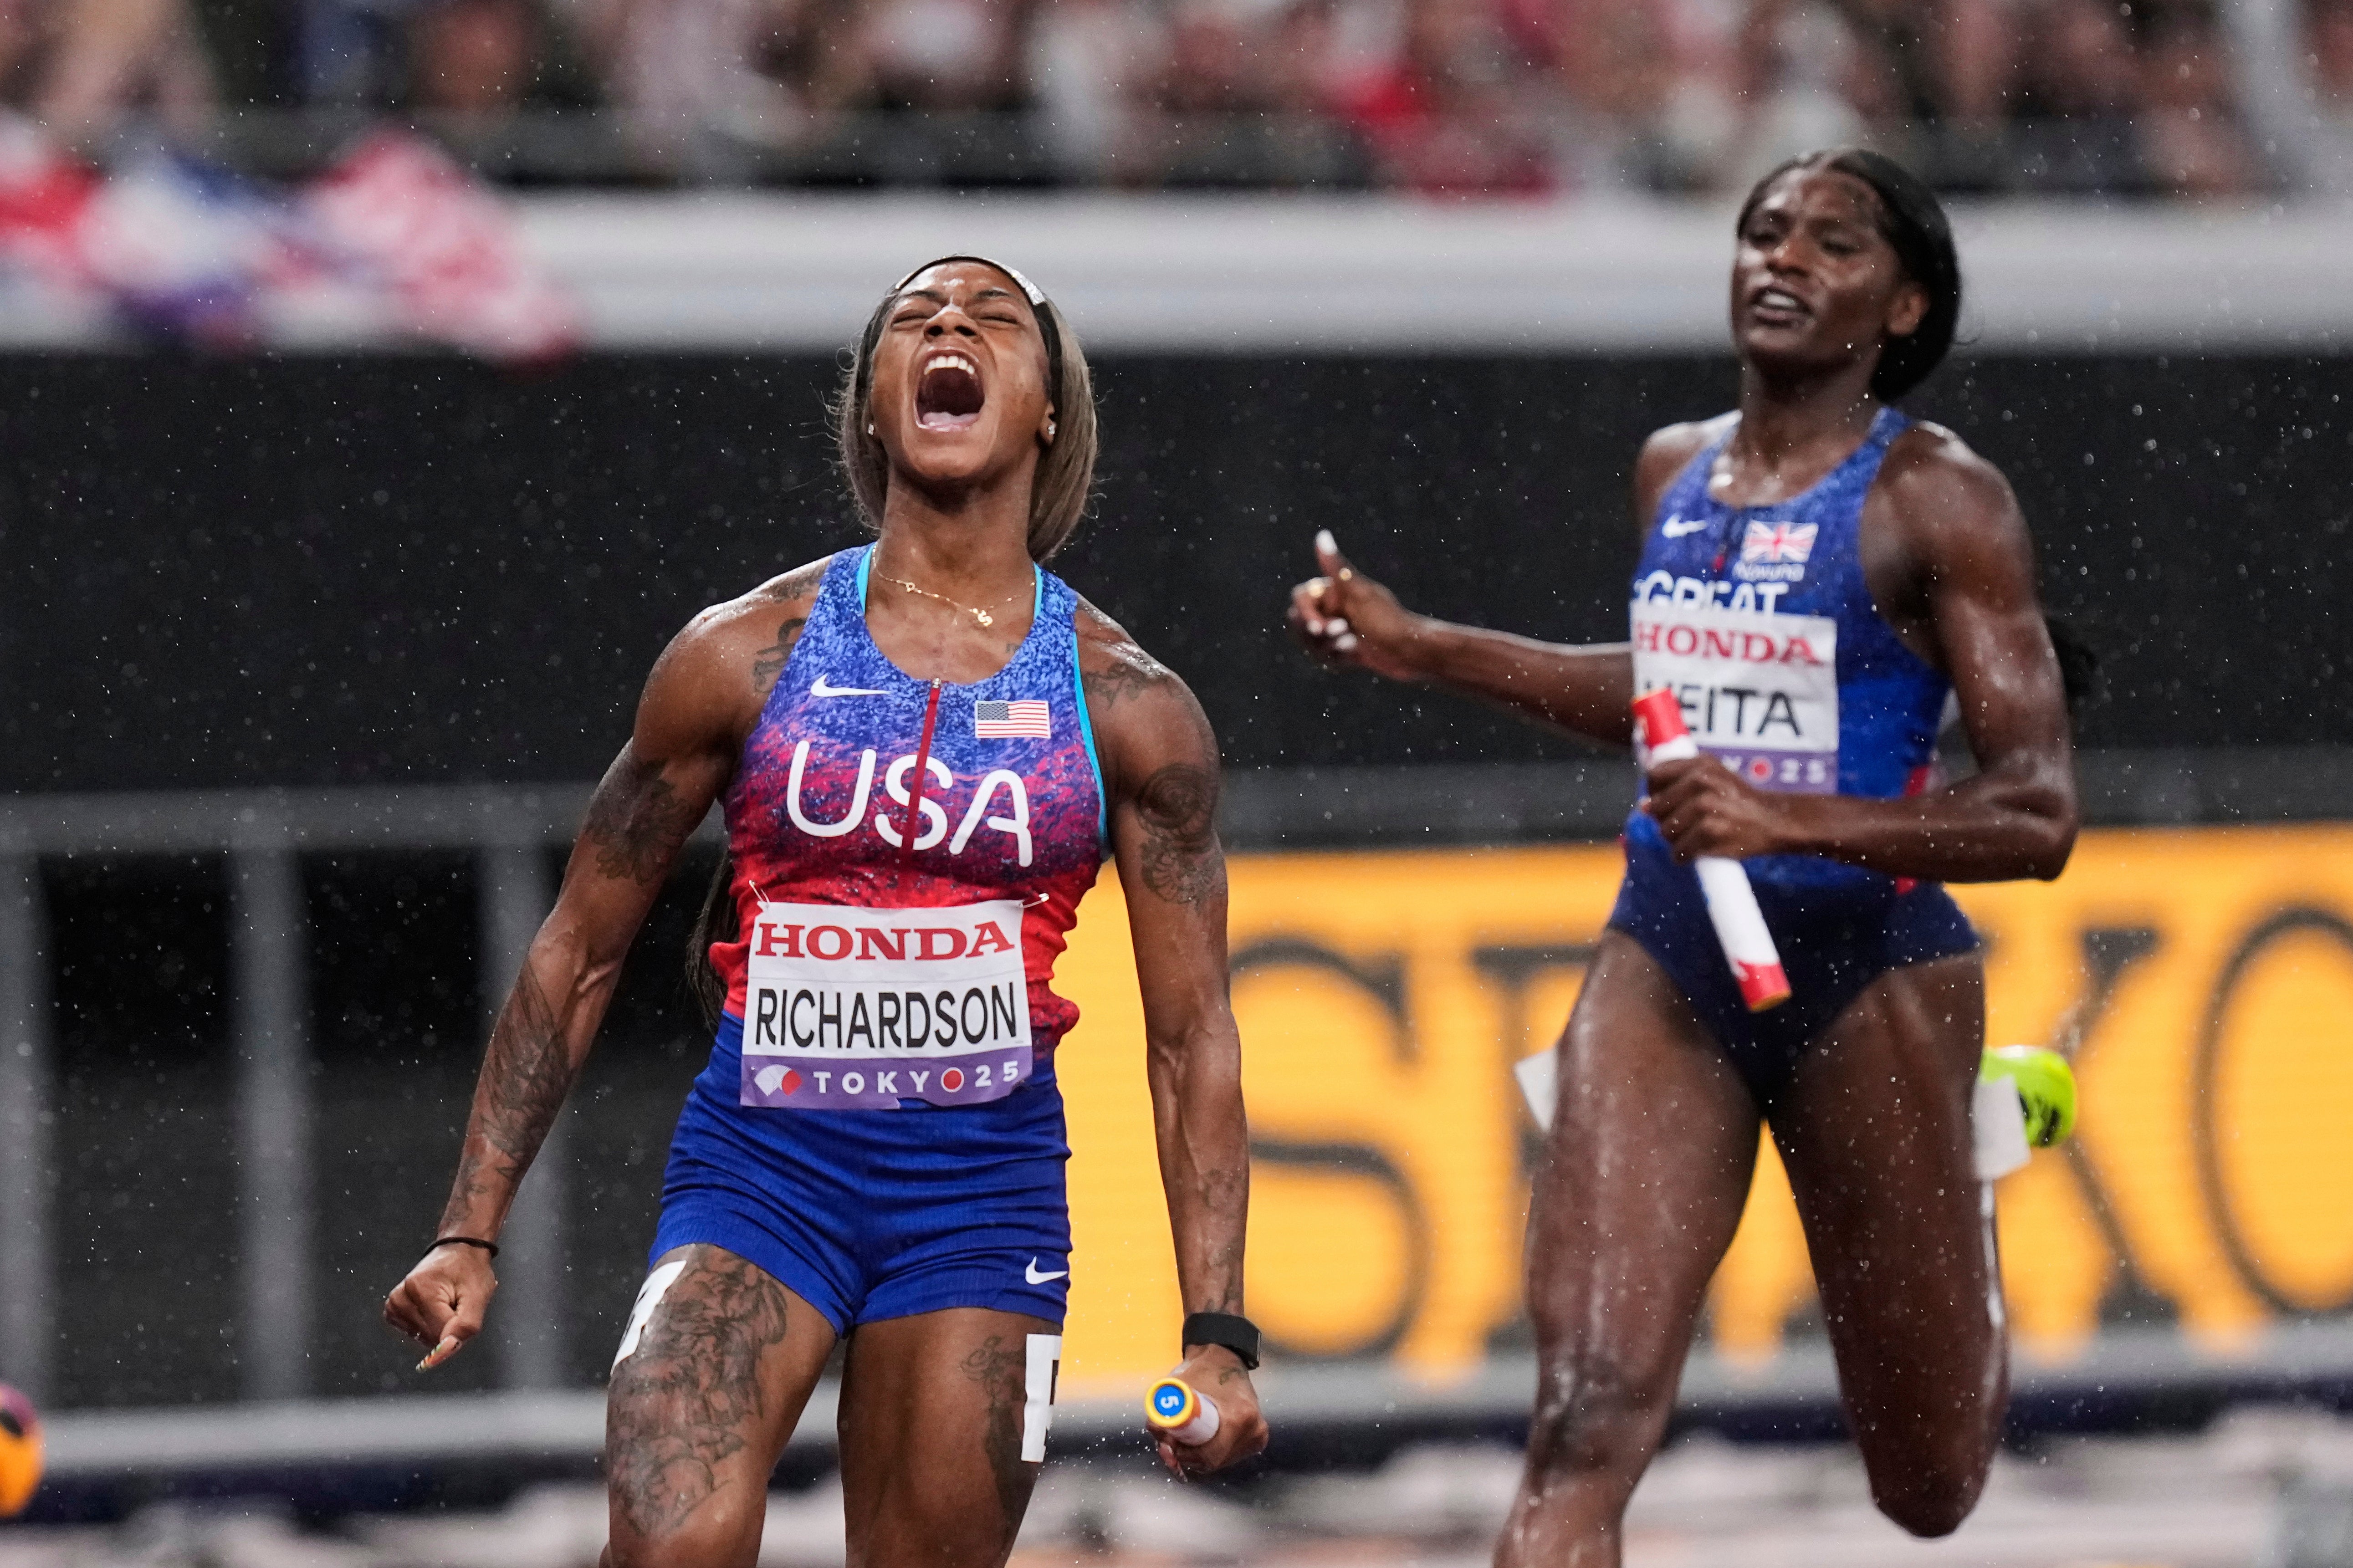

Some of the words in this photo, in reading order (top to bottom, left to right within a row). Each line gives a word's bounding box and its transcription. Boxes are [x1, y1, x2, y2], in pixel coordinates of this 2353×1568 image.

[1636, 624, 1822, 666] HONDA
[1645, 681, 1802, 736] EITA
[787, 740, 1033, 867] USA
[755, 921, 1015, 961] HONDA
[755, 982, 1017, 1048] RICHARDSON
[1160, 1395, 1179, 1409] 5
